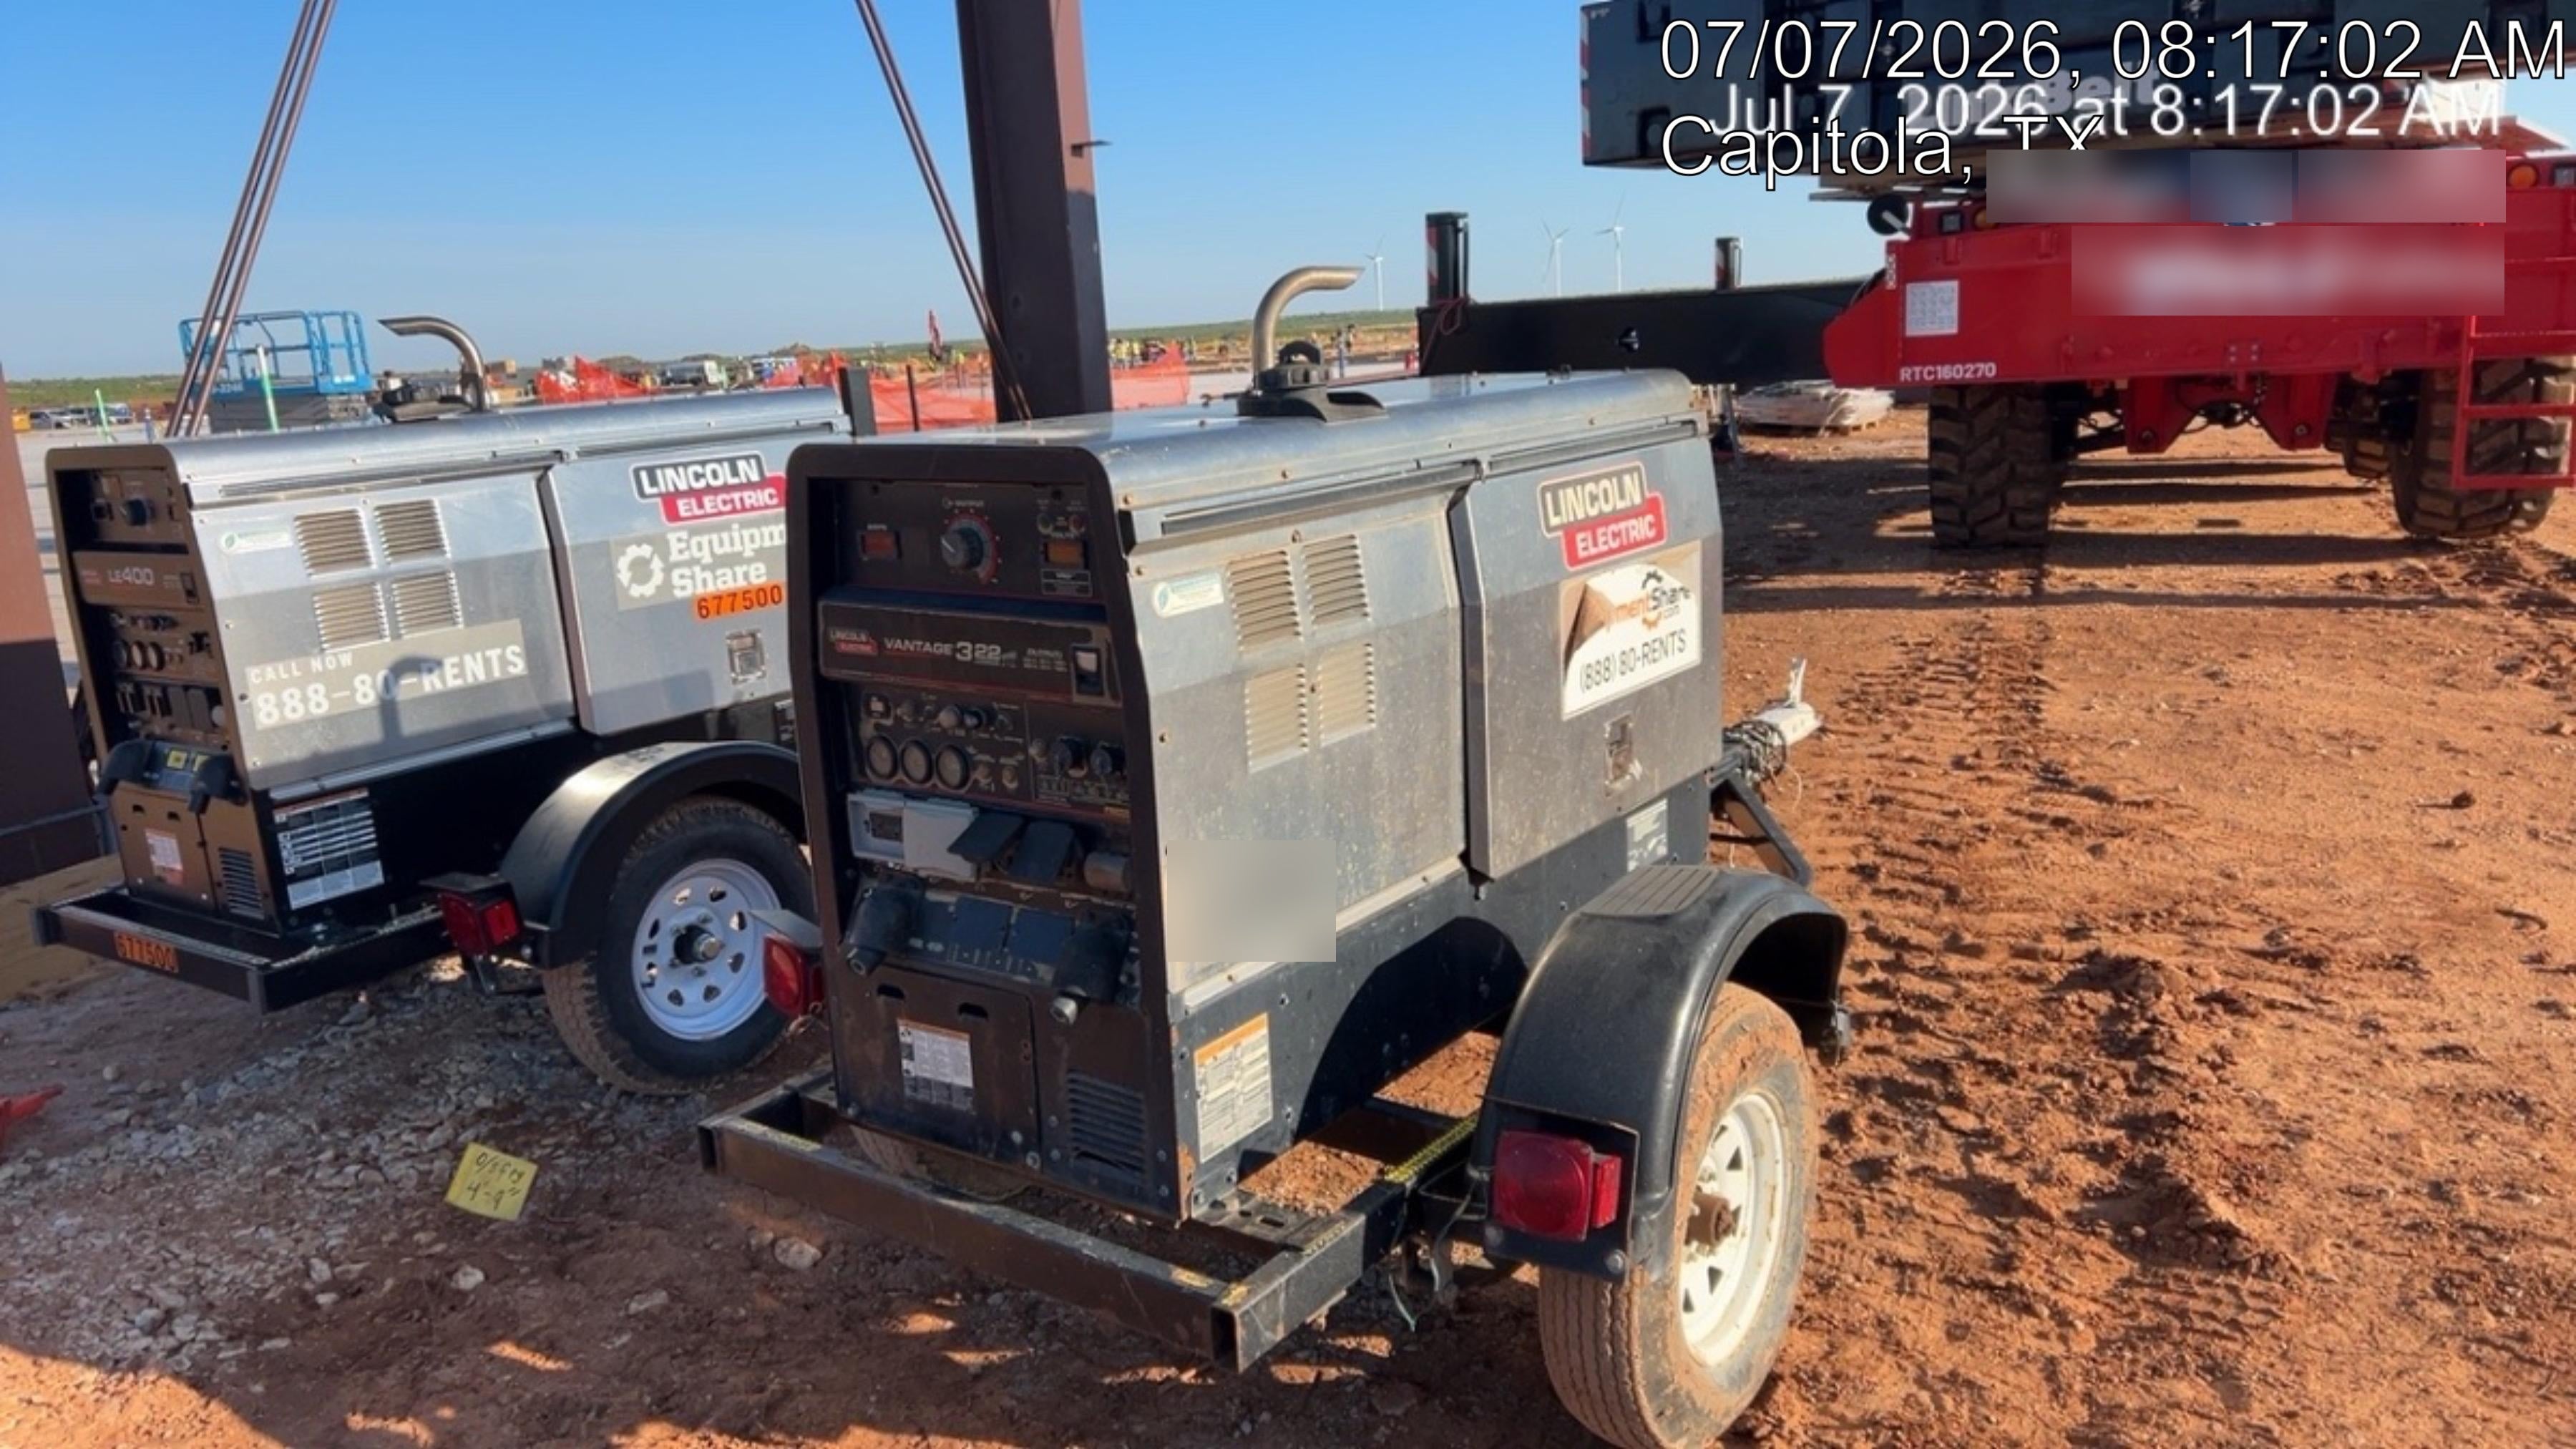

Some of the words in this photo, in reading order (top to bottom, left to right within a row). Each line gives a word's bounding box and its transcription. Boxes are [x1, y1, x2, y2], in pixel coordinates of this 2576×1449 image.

[1899, 361, 1997, 382] RTC160270
[638, 458, 761, 495] LINCOLN
[675, 487, 779, 518] ELECTRIC
[1545, 471, 1642, 528] LINCOLN
[1576, 514, 1657, 558] ELECTRIC
[670, 560, 768, 599] Share
[696, 584, 784, 620] 677500
[884, 637, 954, 657] VANTAGE
[1579, 652, 1617, 695] (888)
[1618, 628, 1687, 677] 80-RENTS
[250, 660, 303, 684] CALL
[310, 651, 353, 673] NOW
[255, 644, 527, 726] 888-80-RENTS
